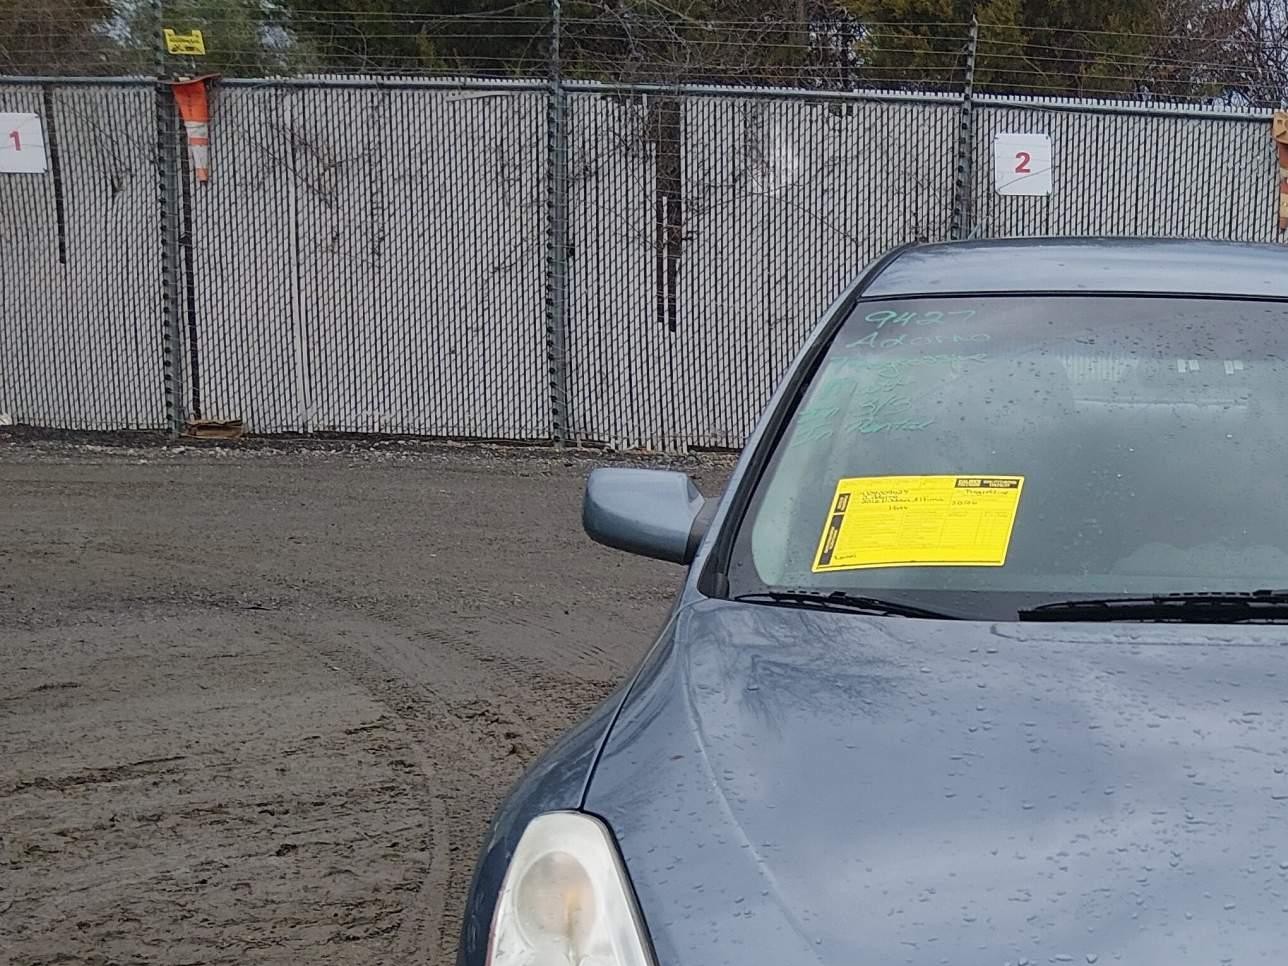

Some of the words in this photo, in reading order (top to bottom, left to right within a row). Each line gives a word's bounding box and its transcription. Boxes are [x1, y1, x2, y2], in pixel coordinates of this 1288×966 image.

[10, 131, 21, 151] 1
[1015, 152, 1031, 173] 2
[864, 310, 977, 329] 9427
